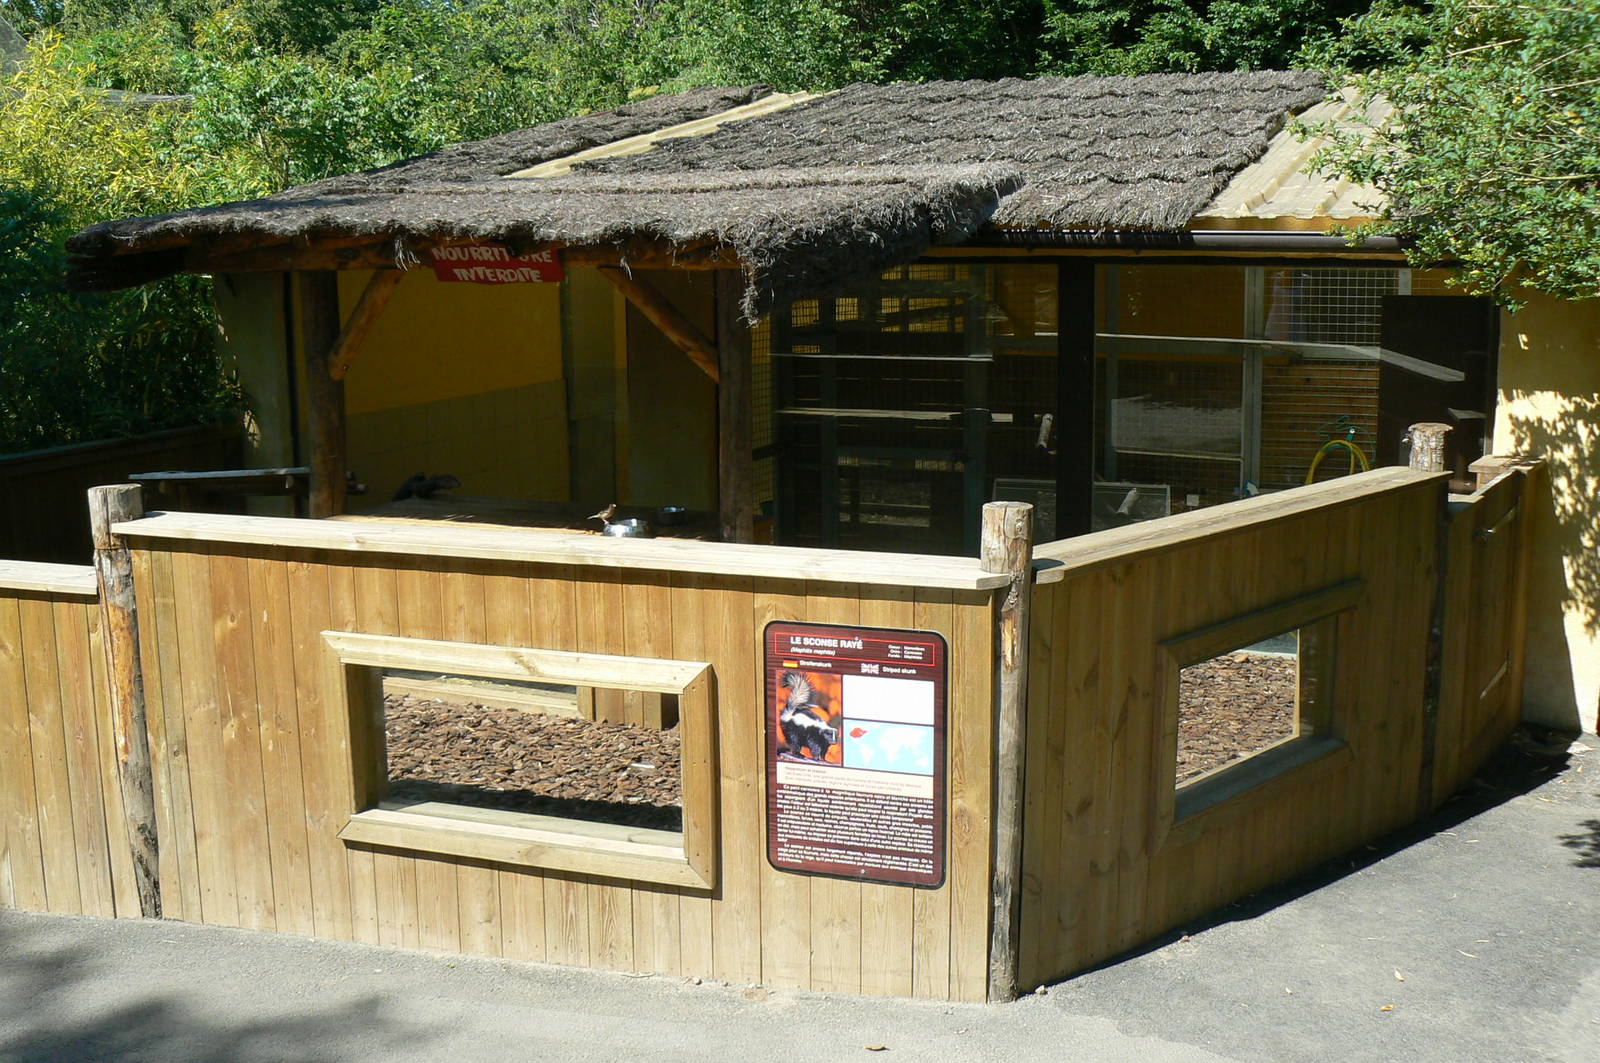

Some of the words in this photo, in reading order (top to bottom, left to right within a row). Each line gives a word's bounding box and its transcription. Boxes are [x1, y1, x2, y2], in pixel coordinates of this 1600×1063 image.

[452, 266, 544, 283] INTERDITE
[790, 636, 802, 645] LE
[803, 637, 838, 648] SCONSE
